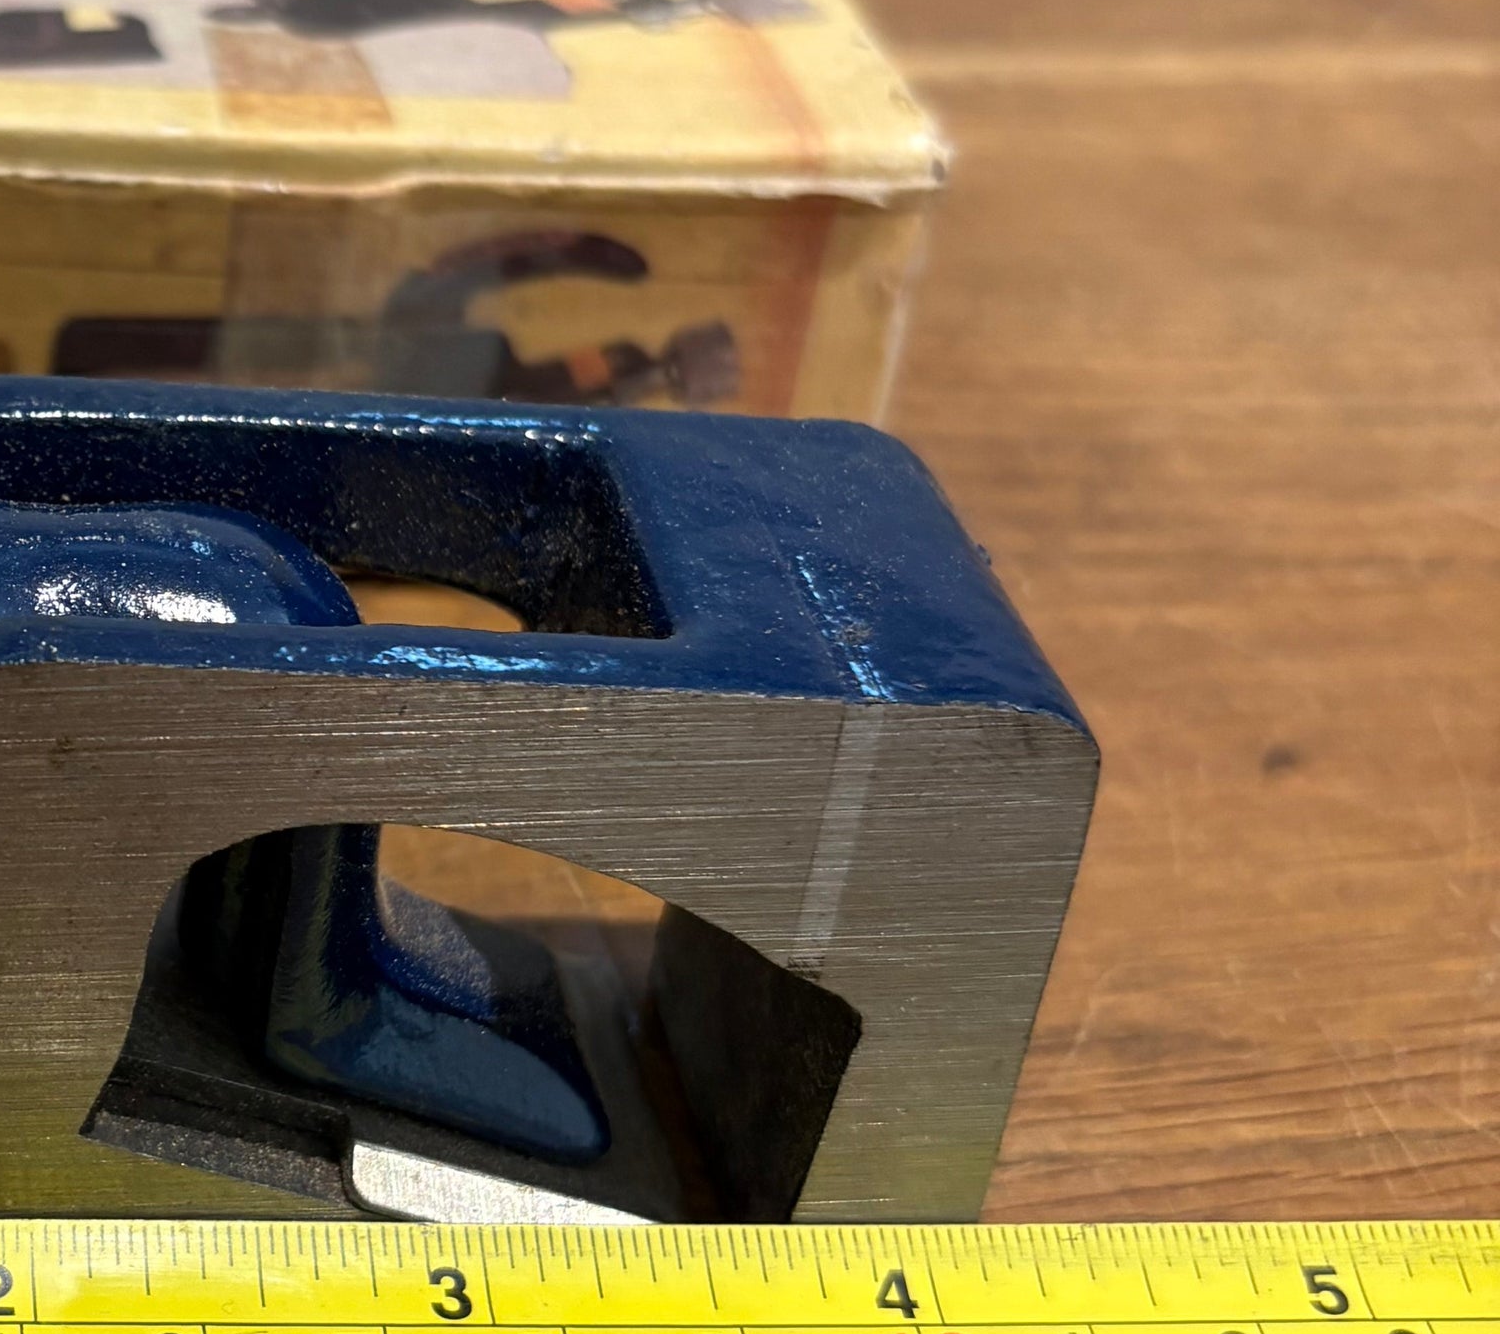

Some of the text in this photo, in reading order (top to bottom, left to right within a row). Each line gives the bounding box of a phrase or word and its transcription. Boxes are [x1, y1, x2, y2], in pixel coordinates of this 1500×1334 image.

[429, 1267, 472, 1320] 3
[875, 1269, 920, 1320] 4
[1301, 1266, 1349, 1316] 5
